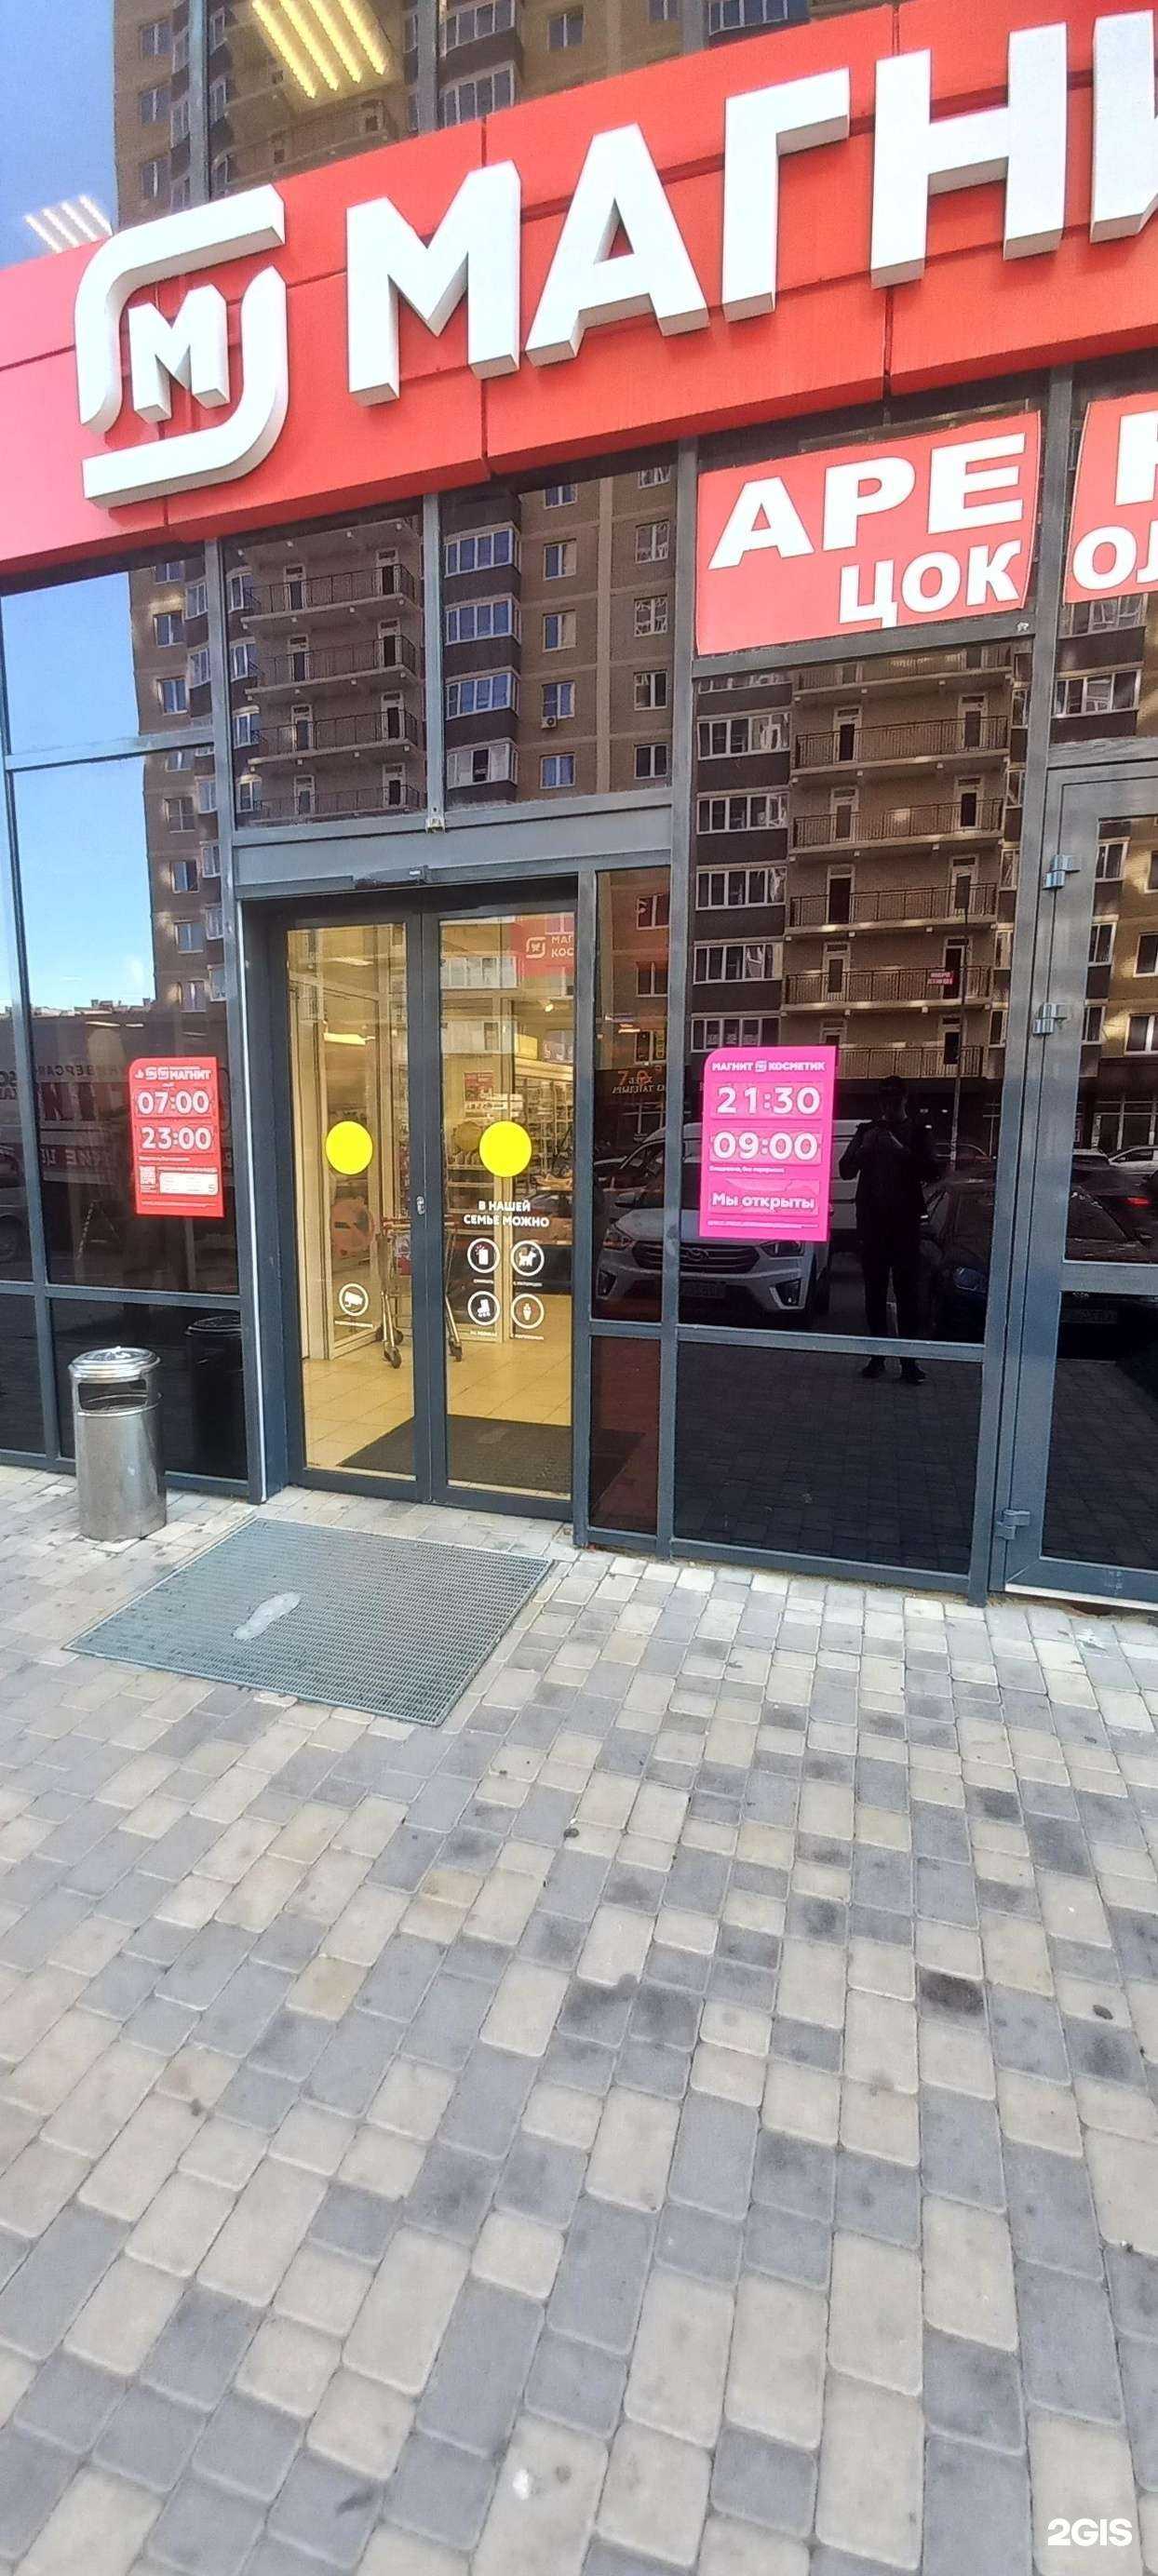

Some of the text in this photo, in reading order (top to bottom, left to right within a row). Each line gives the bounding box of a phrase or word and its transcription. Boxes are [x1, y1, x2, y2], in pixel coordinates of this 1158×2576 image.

[838, 539, 1022, 629] ЦОК
[712, 1062, 754, 1071] МАГНИТ
[137, 1090, 209, 1115] 07:00
[716, 1085, 821, 1115] 21:30
[141, 1126, 212, 1150] 23:00
[713, 1131, 819, 1161] 09:00
[478, 1200, 532, 1212] В НАШЕЙ
[711, 1191, 815, 1211] Мы открыты
[463, 1214, 550, 1228] СЕМЬЕ МОЖНО
